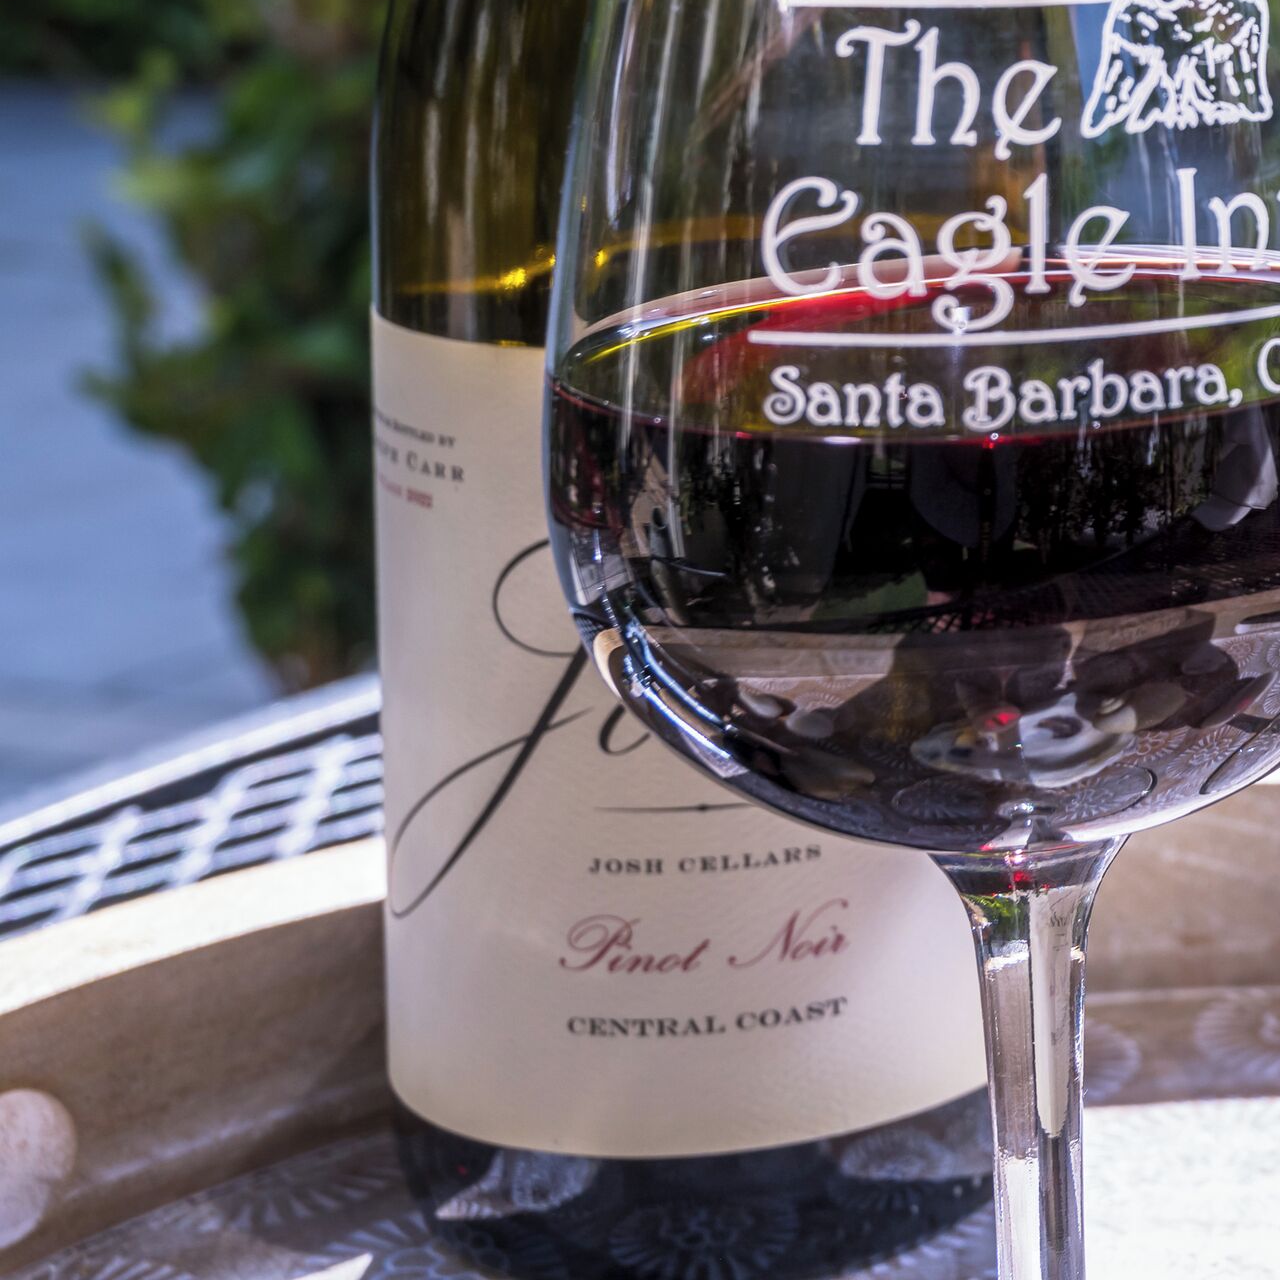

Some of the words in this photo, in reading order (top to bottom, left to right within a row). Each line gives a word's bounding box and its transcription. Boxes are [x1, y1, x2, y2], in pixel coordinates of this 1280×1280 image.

[835, 19, 1063, 160] The
[761, 173, 1136, 334] Eagle
[762, 365, 944, 426] Santa
[962, 357, 1244, 431] Barbara,
[588, 857, 664, 876] JOSH
[677, 844, 823, 873] CELLARS
[558, 913, 711, 975] Pinot
[726, 897, 850, 970] Noir
[566, 1015, 727, 1038] CENTRAL
[735, 996, 849, 1032] COAST
